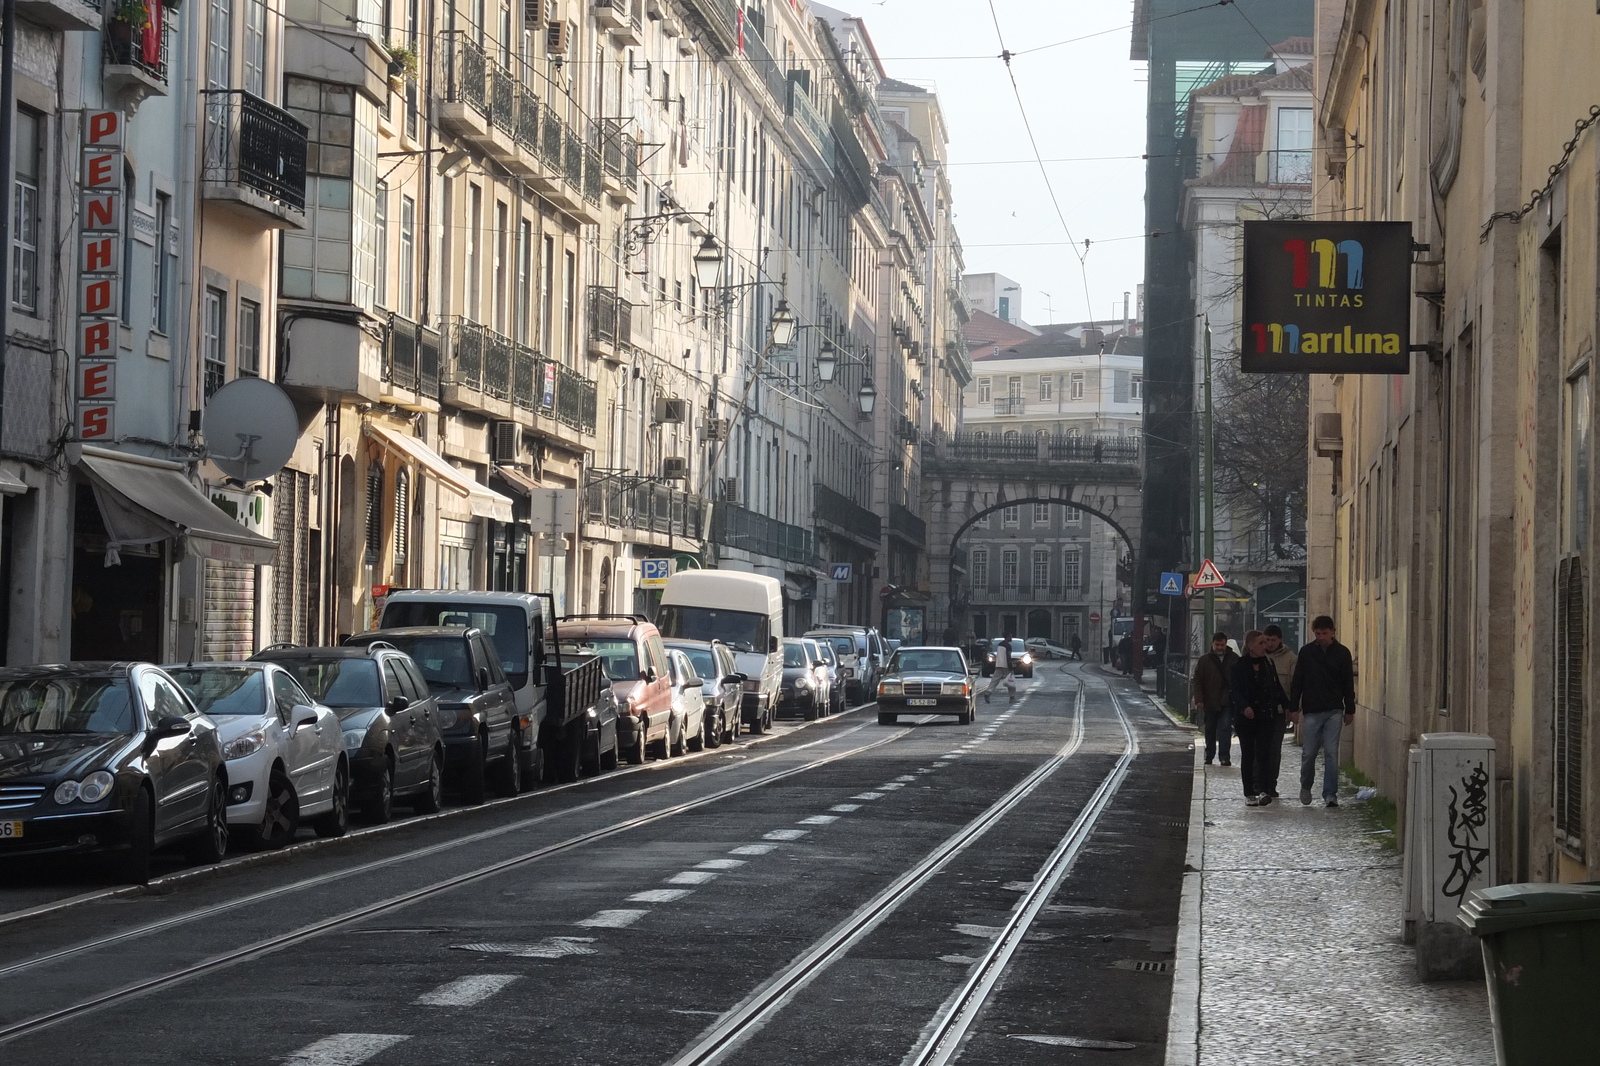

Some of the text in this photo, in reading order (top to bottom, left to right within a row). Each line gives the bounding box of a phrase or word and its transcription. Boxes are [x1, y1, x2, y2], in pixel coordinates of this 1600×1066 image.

[82, 112, 117, 438] PENHORES
[1294, 294, 1364, 308] TINTAS
[644, 561, 657, 578] P
